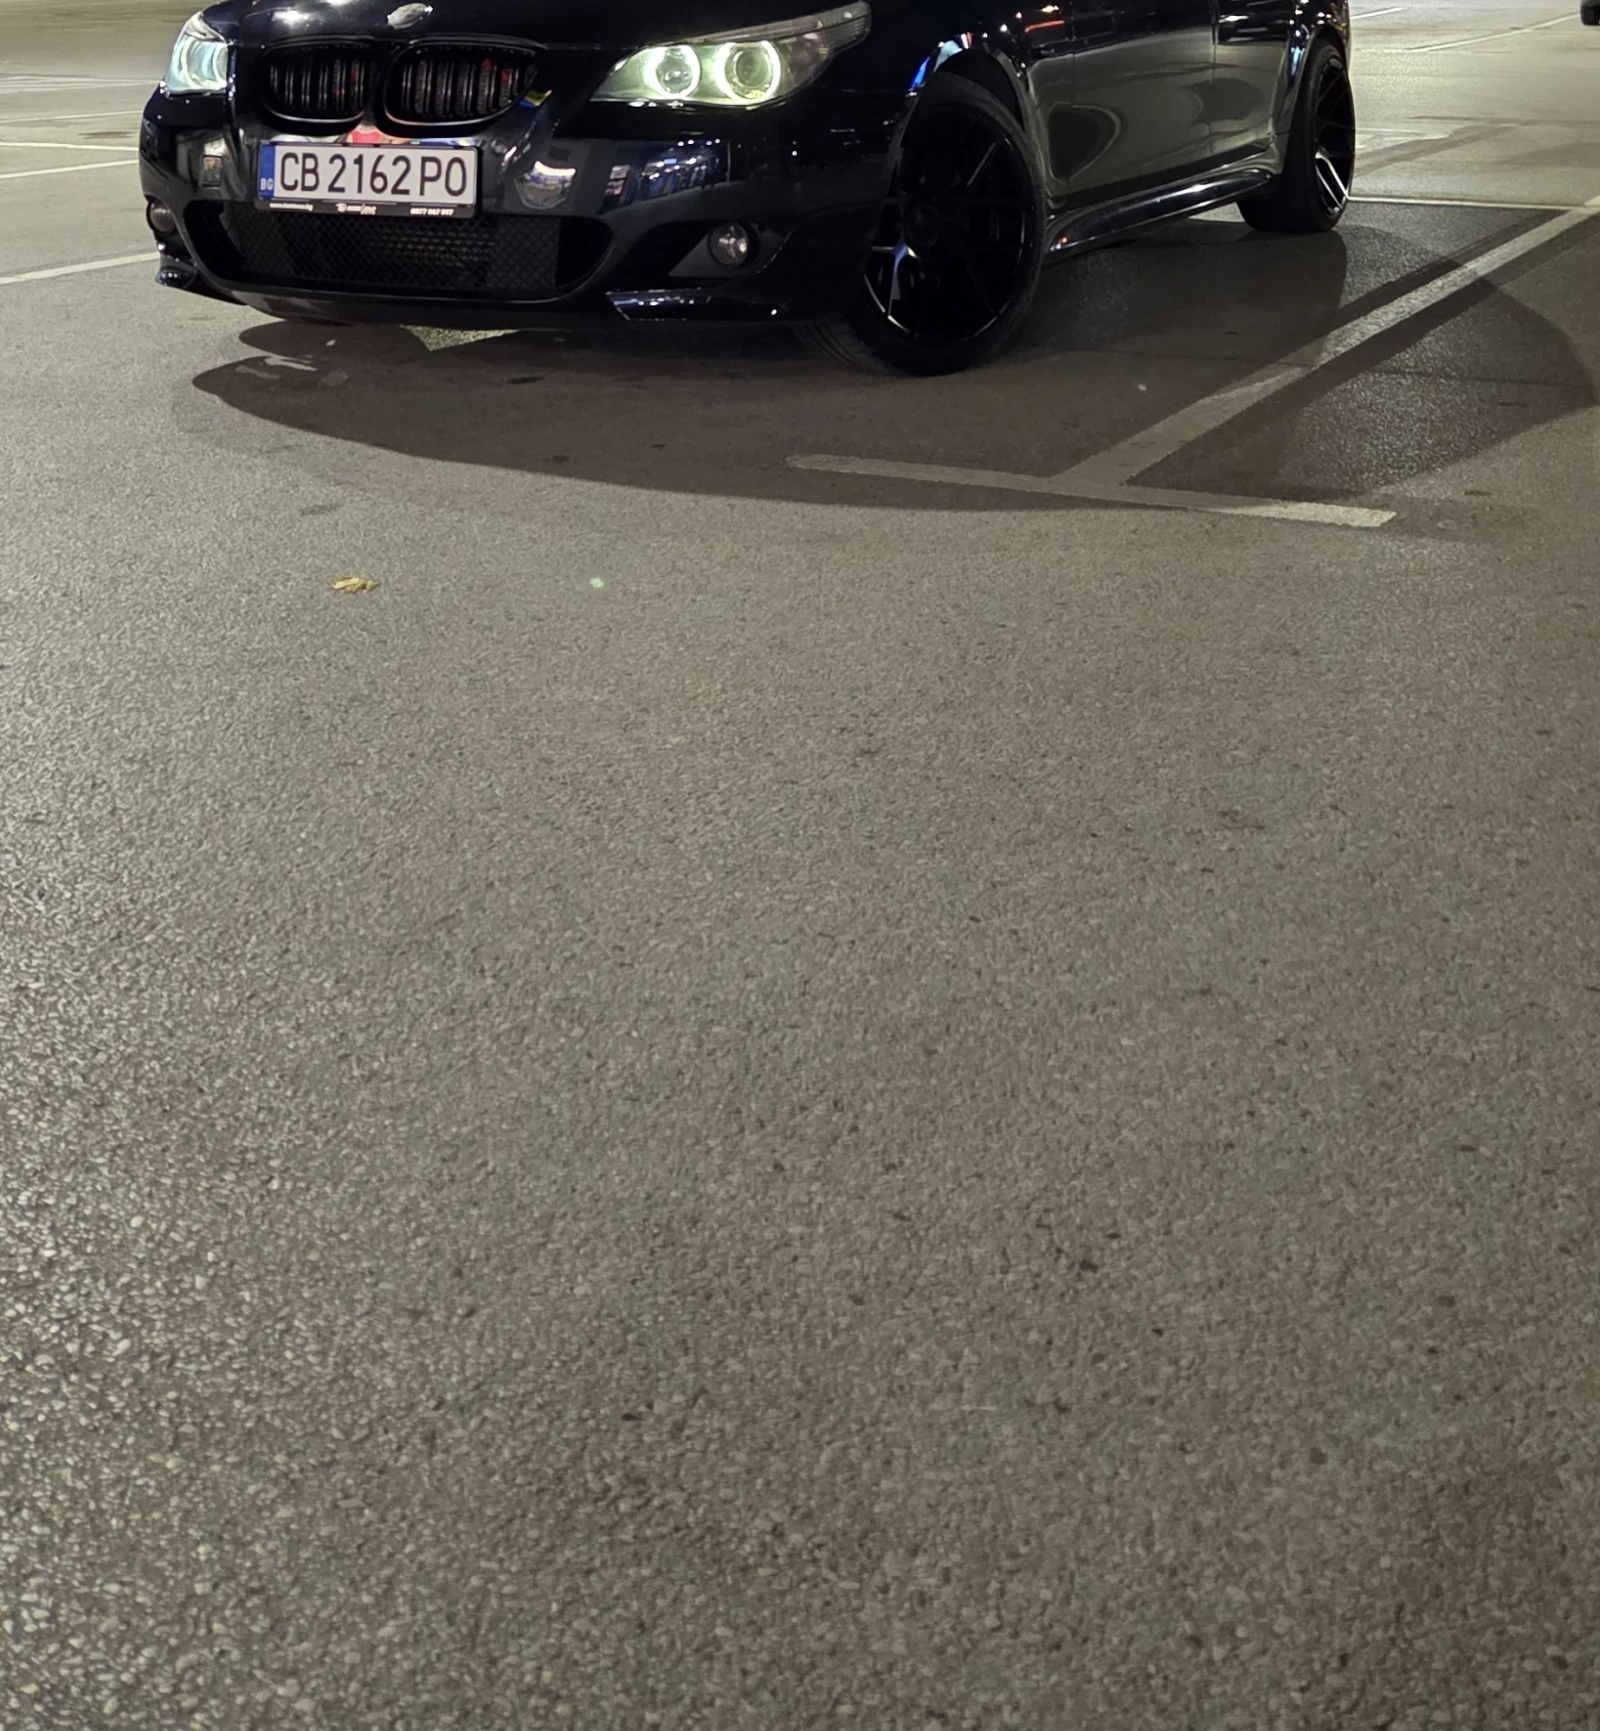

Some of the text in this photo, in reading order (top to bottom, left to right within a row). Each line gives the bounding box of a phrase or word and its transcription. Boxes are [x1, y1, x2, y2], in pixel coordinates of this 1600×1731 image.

[260, 177, 274, 191] BG
[280, 152, 467, 197] CB 2162 PO
